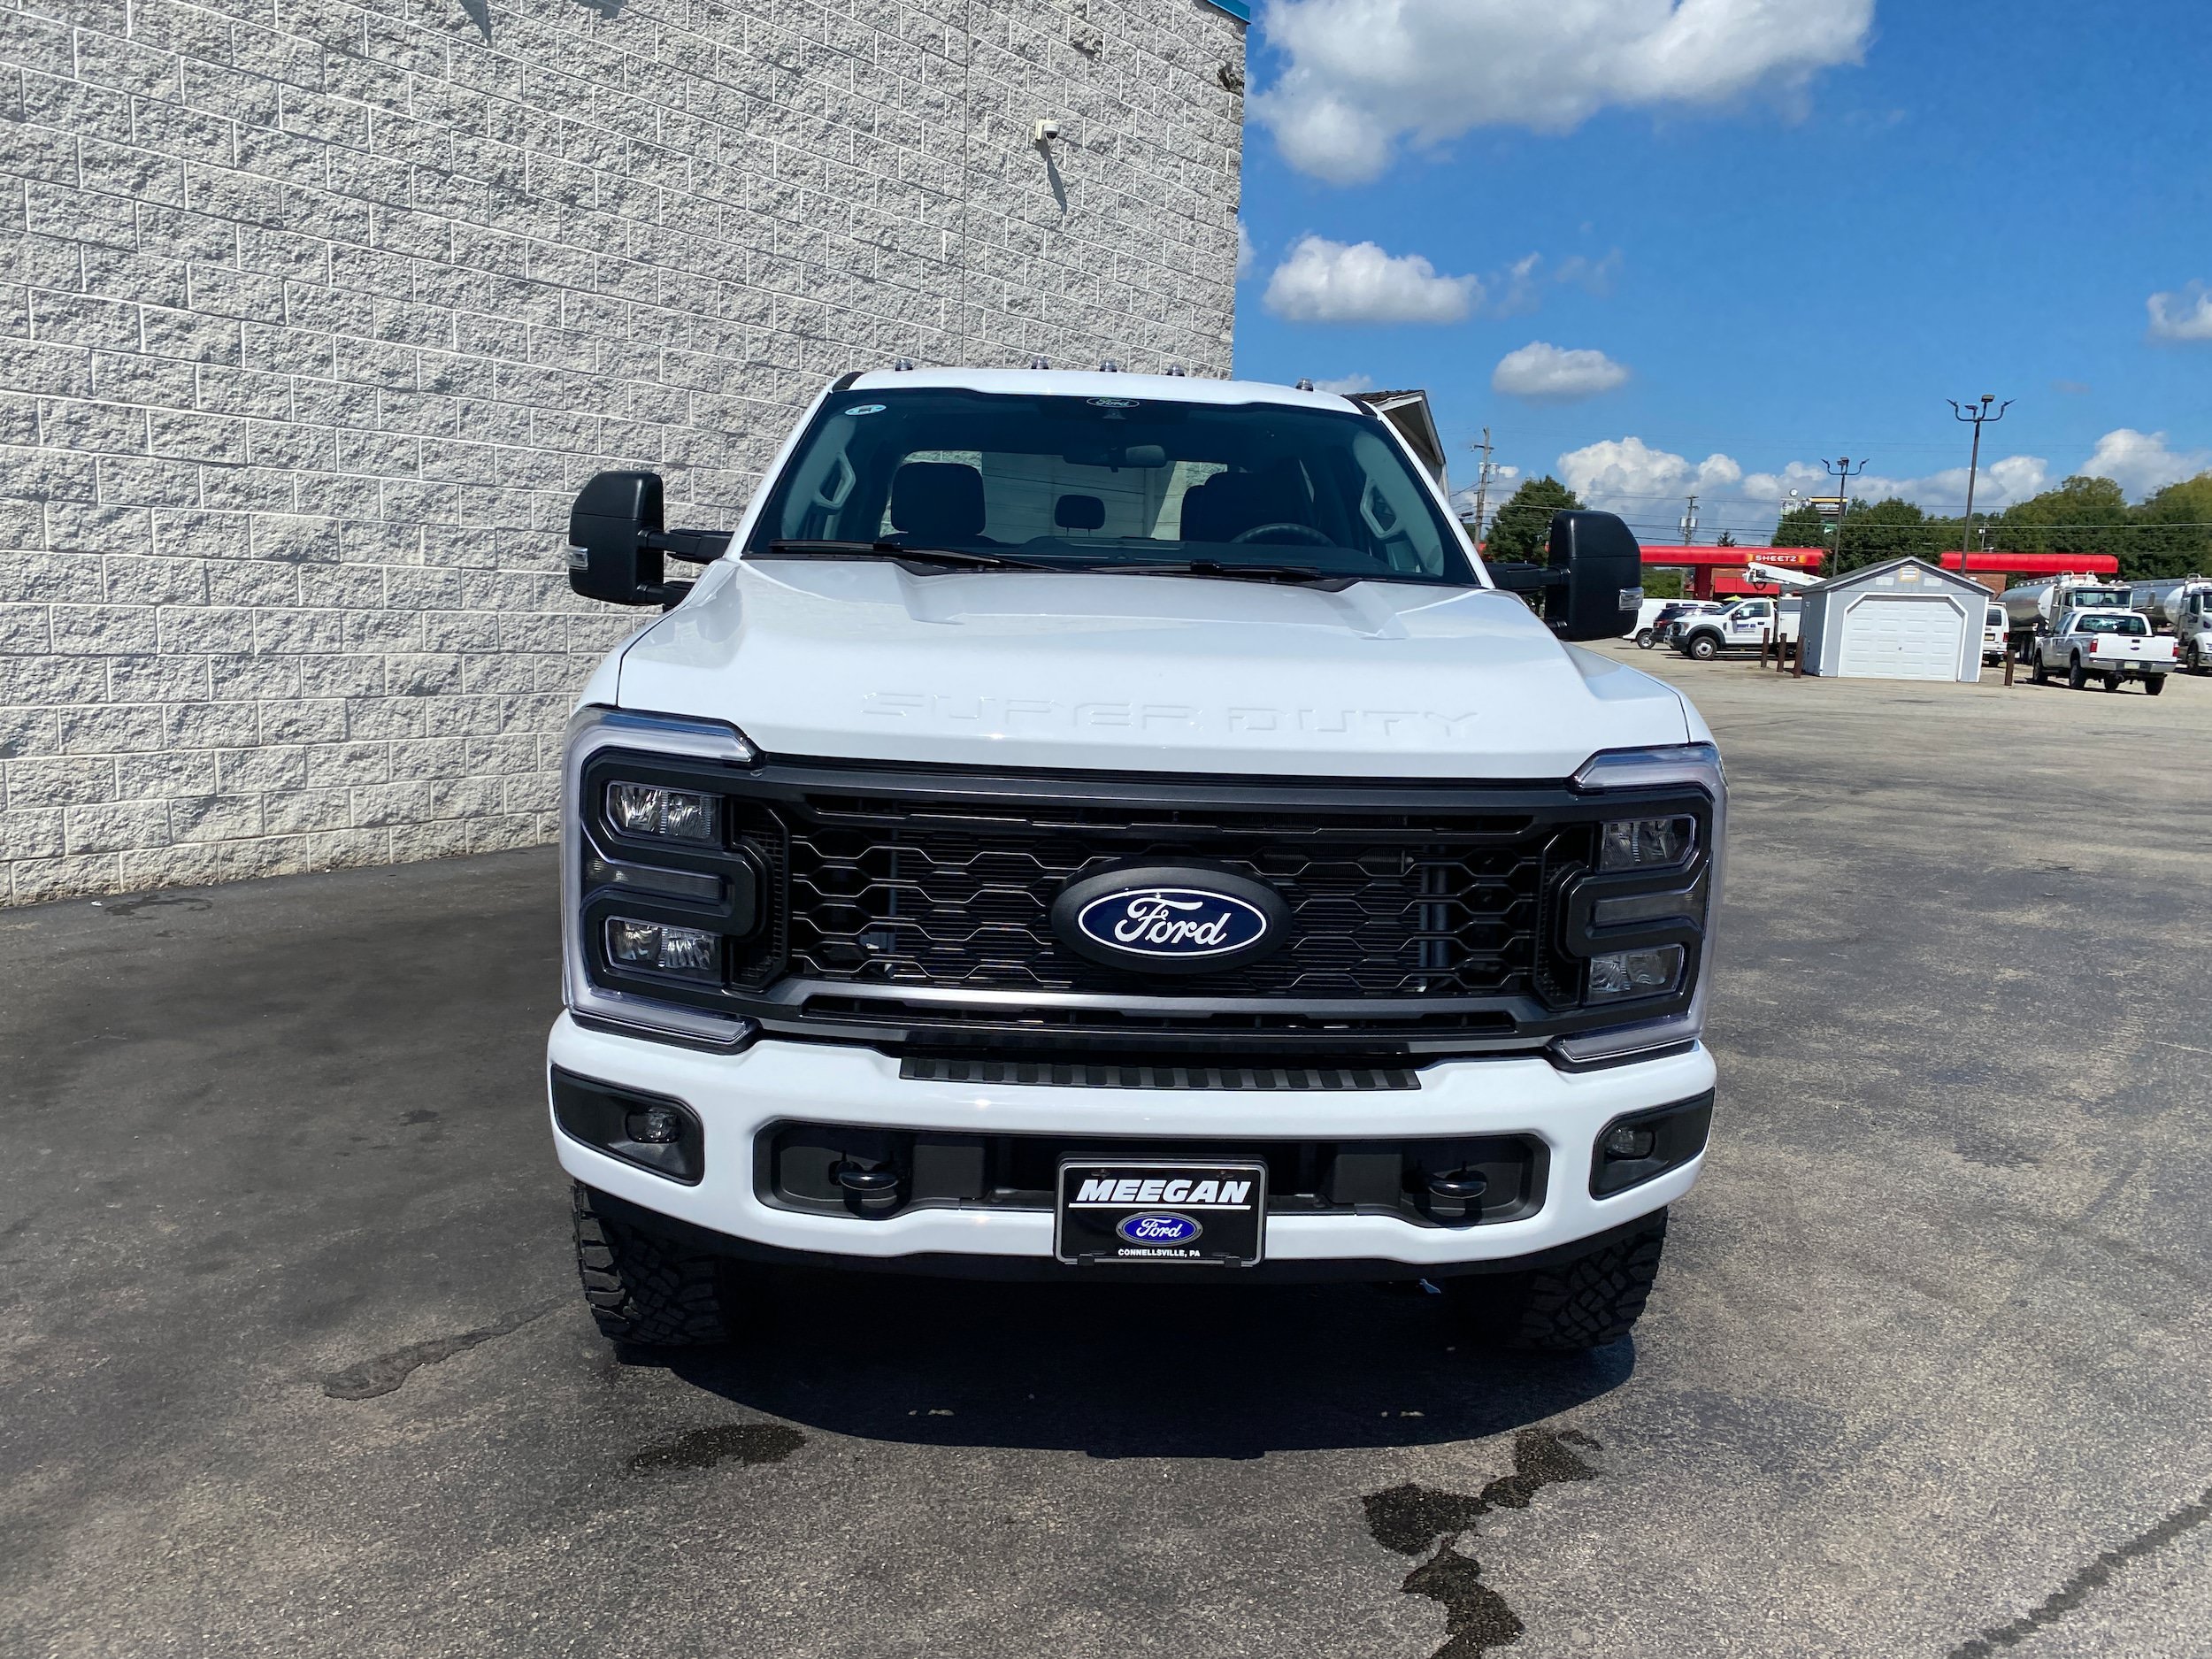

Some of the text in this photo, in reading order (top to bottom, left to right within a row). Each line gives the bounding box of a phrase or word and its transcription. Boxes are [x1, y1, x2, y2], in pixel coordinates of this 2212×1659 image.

[860, 691, 1479, 737] SUPER DUTY
[1114, 897, 1232, 946] Ford
[1076, 1179, 1251, 1204] MEEGAN
[1135, 1218, 1183, 1239] Ford
[1118, 1248, 1187, 1257] CONNELLSVILLE,
